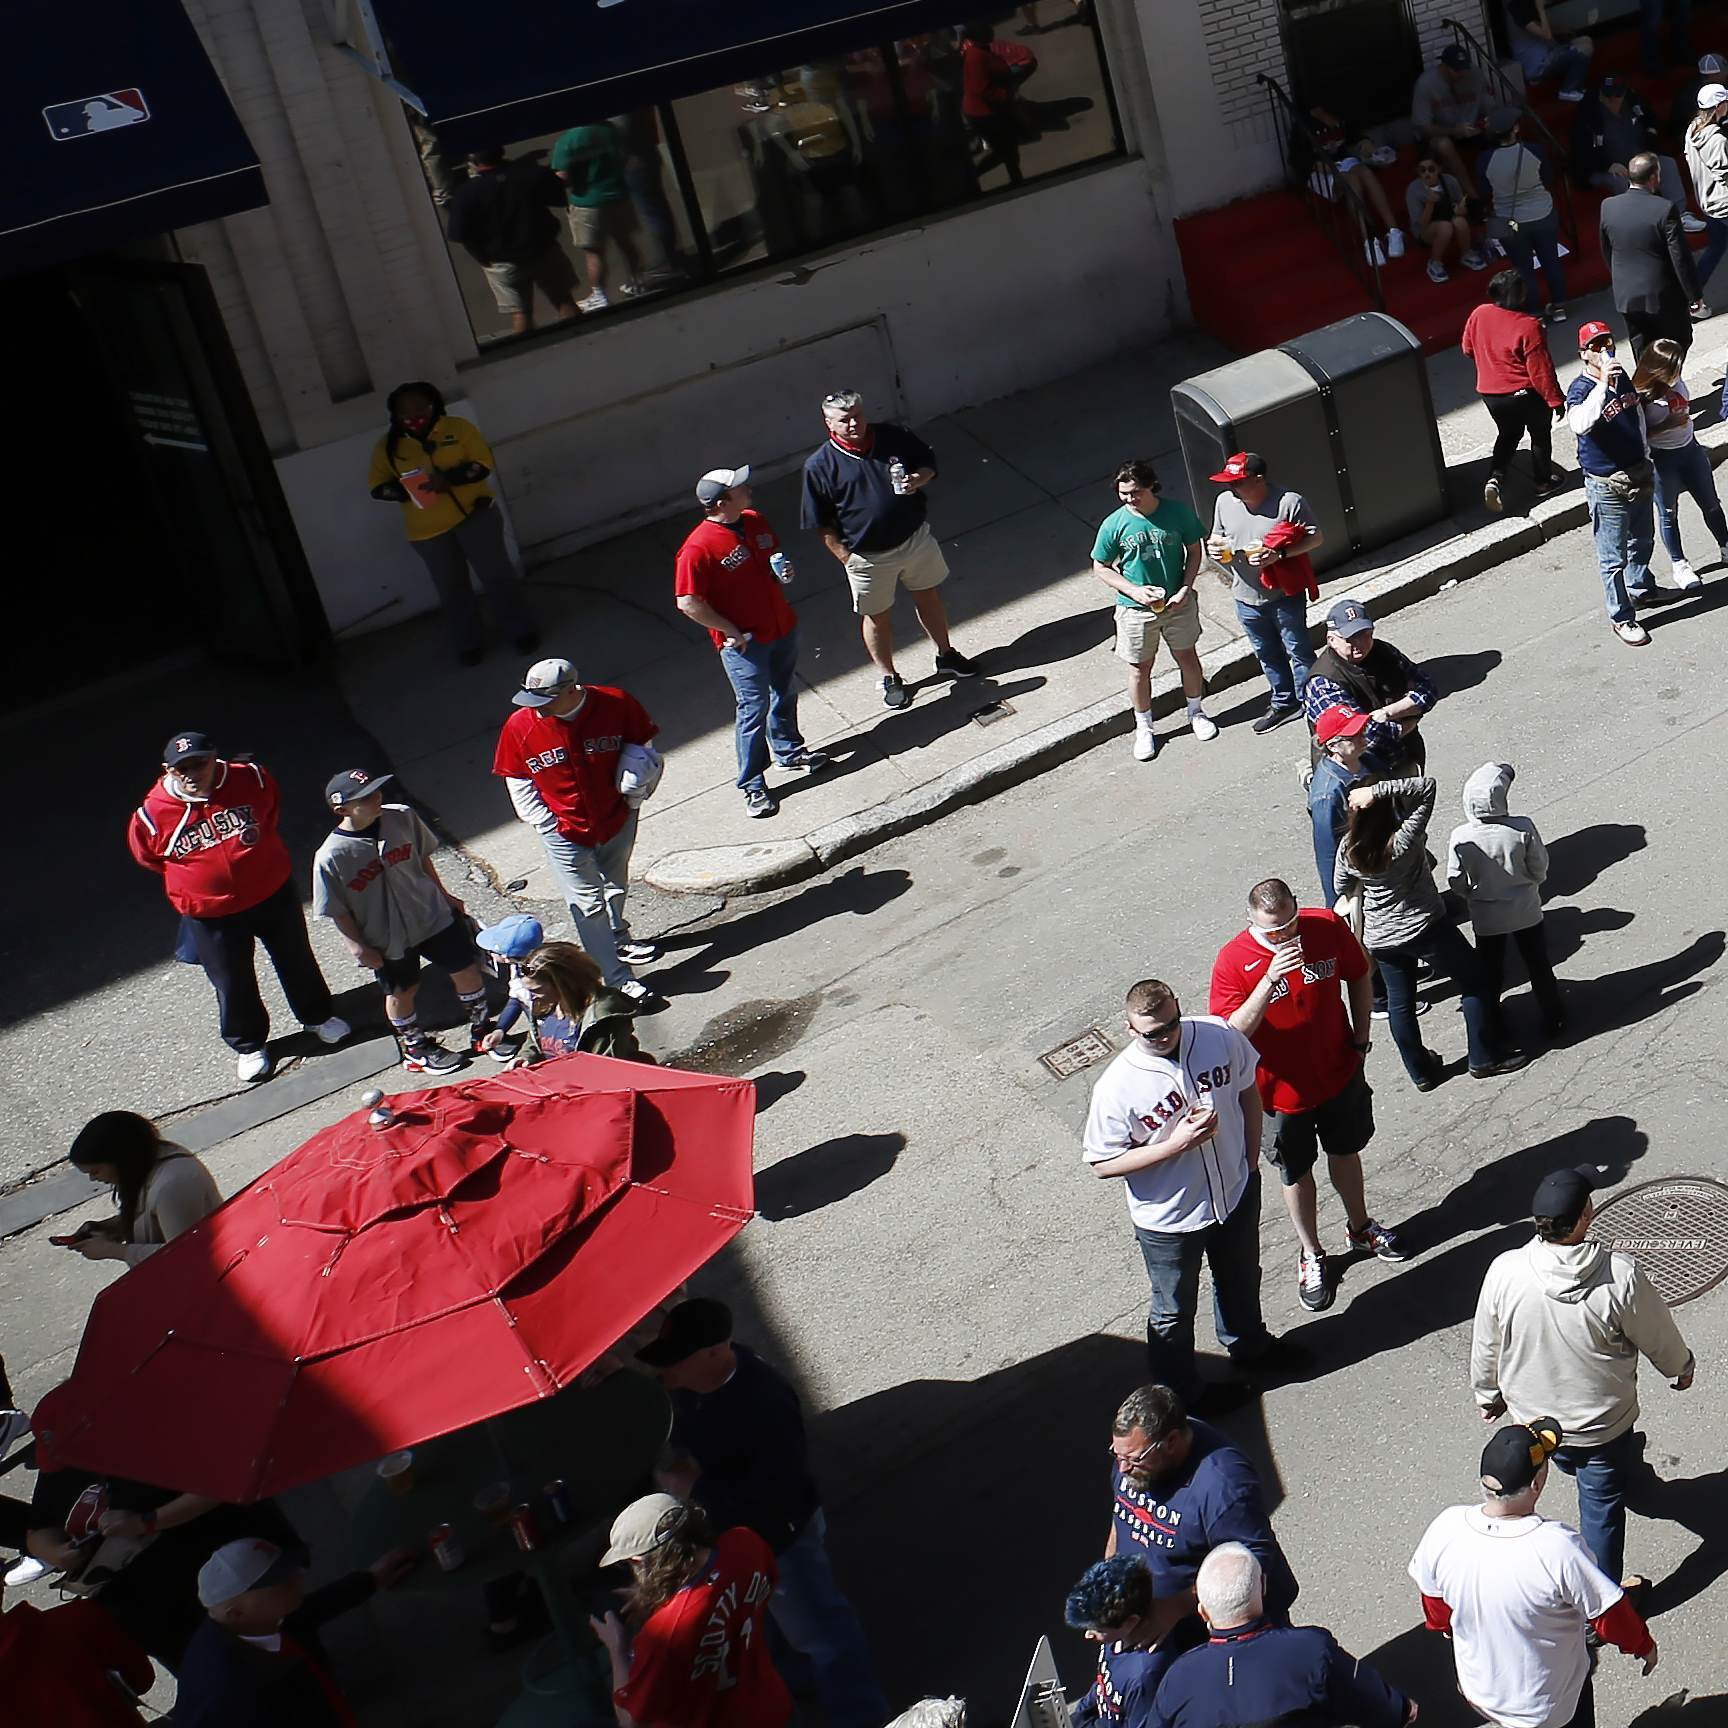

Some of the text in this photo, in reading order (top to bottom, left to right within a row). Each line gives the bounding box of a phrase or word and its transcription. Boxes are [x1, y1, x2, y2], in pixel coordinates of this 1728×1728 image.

[526, 746, 567, 774] RED
[215, 804, 257, 839] SOX
[1136, 1090, 1184, 1131] RED
[1614, 1238, 1706, 1250] EVERSOURCE
[1118, 1475, 1183, 1527] BOSTON
[1113, 1502, 1176, 1550] BASEBALL
